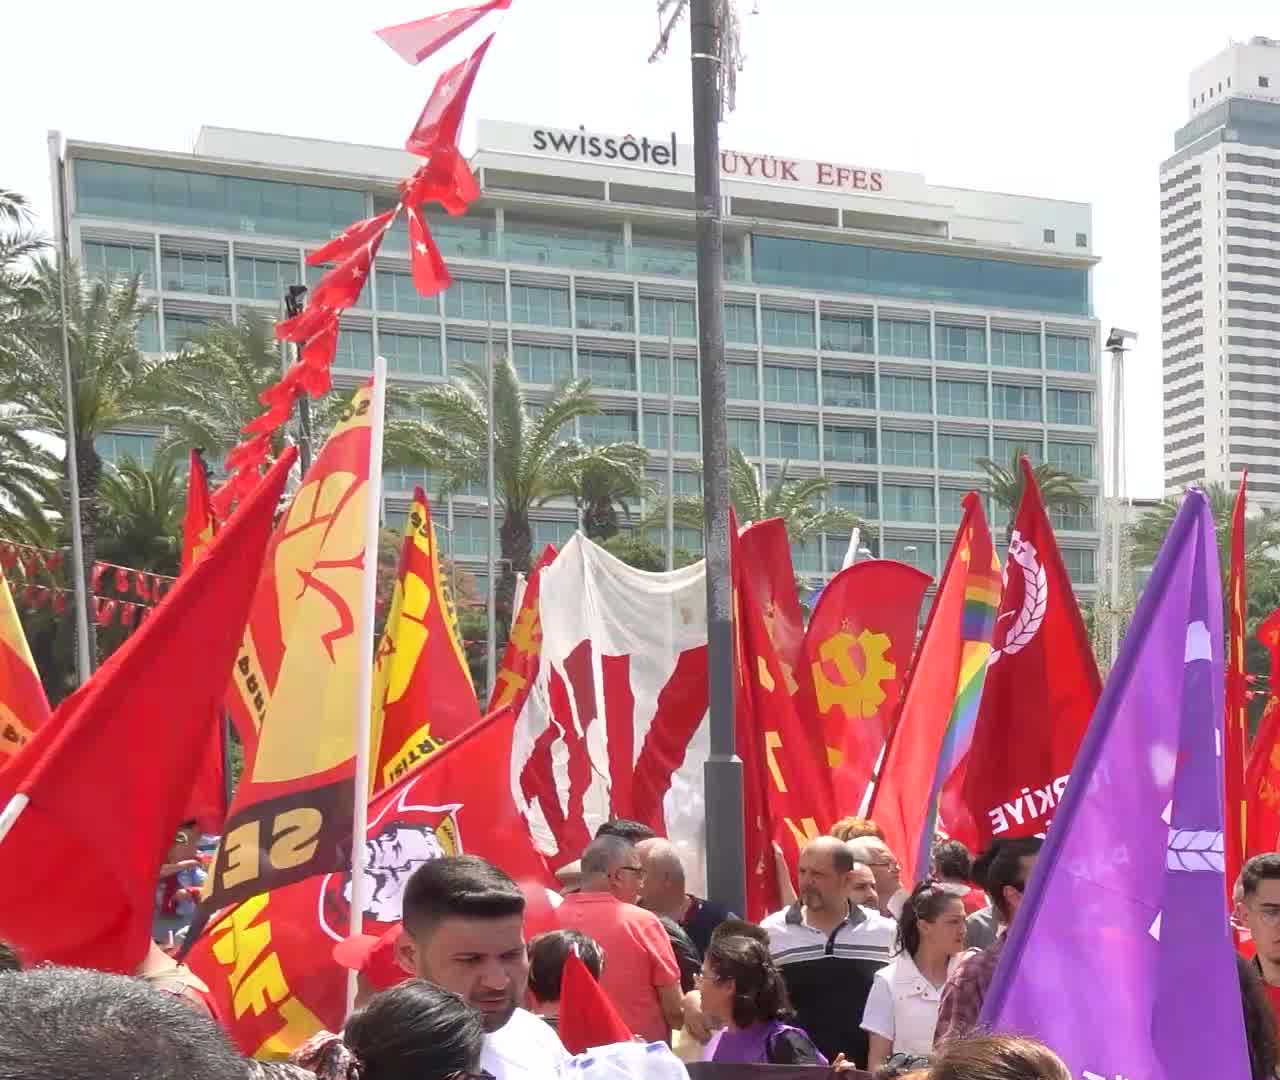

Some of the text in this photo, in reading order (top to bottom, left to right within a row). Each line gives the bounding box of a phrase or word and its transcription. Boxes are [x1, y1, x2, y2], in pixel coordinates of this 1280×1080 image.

[533, 125, 678, 166] swissôtel
[721, 150, 883, 192] ÜYÜK EFES
